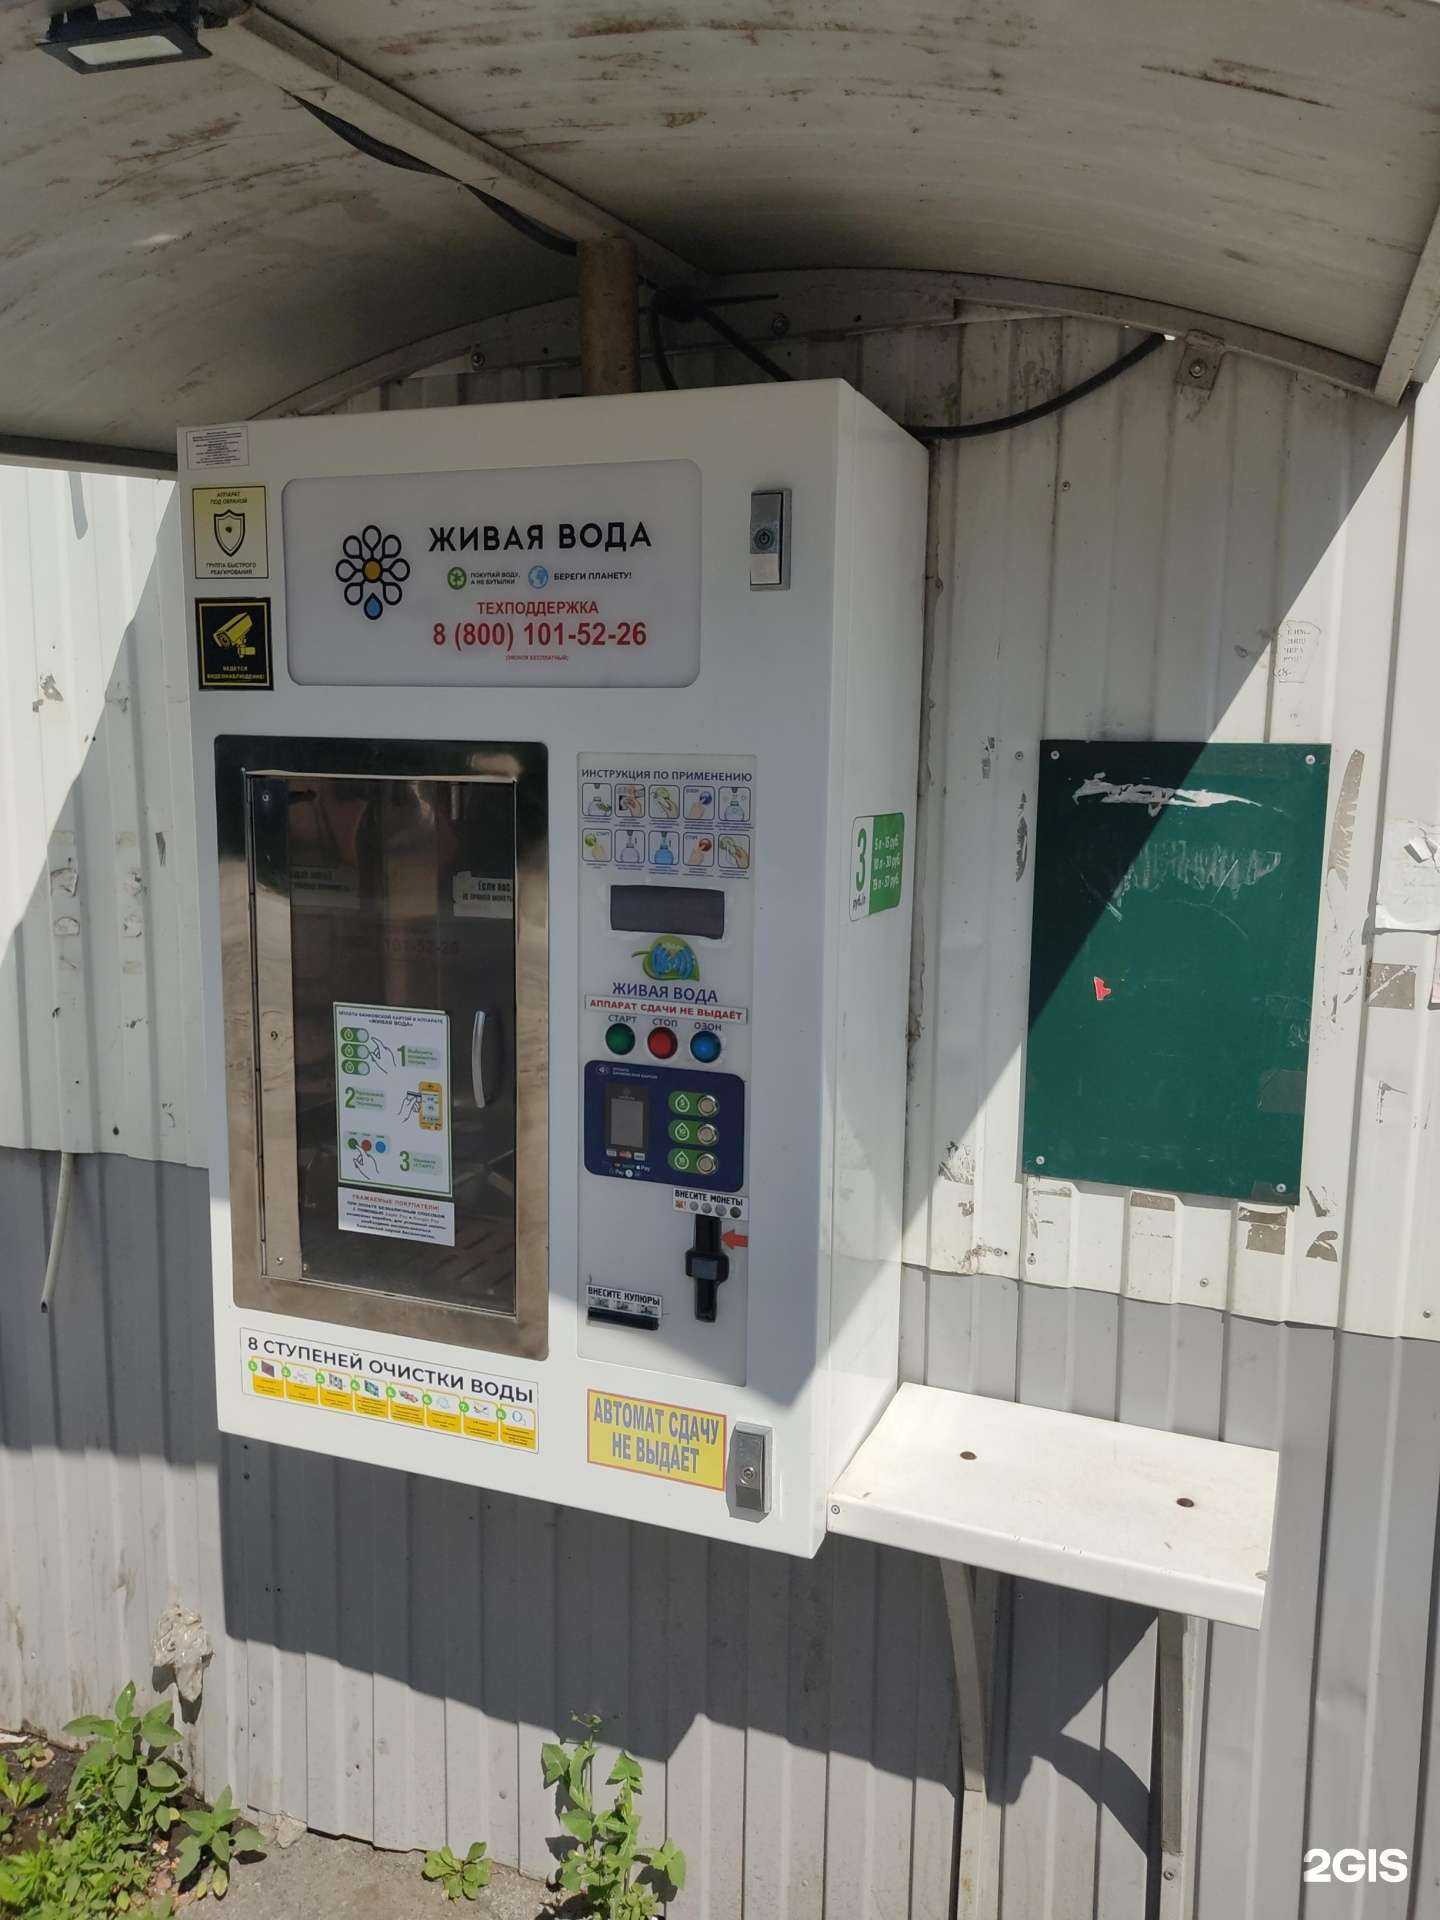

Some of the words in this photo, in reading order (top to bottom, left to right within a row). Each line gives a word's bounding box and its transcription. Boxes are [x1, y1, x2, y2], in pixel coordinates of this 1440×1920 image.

[429, 524, 544, 551] ЖИВАЯ
[558, 521, 652, 552] ВОДА
[554, 572, 587, 581] БЕРЕГИ
[588, 571, 632, 580] ПЛАНЕТУ!
[478, 601, 599, 616] ТЕХПОДДЕРЖКА
[433, 623, 446, 645] 8
[455, 622, 514, 651] (800)
[524, 622, 647, 646] 101-52-26
[582, 769, 650, 780] ИНСТРУКЦИЯ
[653, 771, 669, 780] ПО
[672, 772, 752, 782] ПРИМЕНЕНИЮ
[856, 828, 866, 892] 3
[612, 982, 669, 999] ЖИВАЯ
[674, 987, 718, 1005] ВОДА
[590, 999, 637, 1011] АППАРАТ
[641, 1004, 677, 1014] СДАЧИ
[680, 1007, 694, 1015] НЕ
[608, 1014, 637, 1023] СТАРТ
[652, 1018, 678, 1027] СТОП
[694, 1022, 722, 1032] ОЗОН
[398, 1045, 405, 1066] 1
[345, 1087, 356, 1109] 2
[400, 1151, 410, 1172] 3
[674, 1190, 707, 1201] ВНЕСИТЕ
[710, 1195, 743, 1206] МОНЕТЫ
[588, 1286, 621, 1299] ВНЕСИТЕ
[624, 1292, 660, 1306] КУПЮРЫ
[248, 1337, 257, 1350] 8
[264, 1340, 362, 1372] СТУПЕНЕЙ
[369, 1360, 464, 1390] ОЧИСТКИ
[471, 1379, 533, 1403] ВОДЫ
[594, 1398, 664, 1434] АВТОМАТ
[669, 1412, 719, 1445] СДАЧУ
[612, 1432, 631, 1460] НЕ
[636, 1437, 699, 1473] ВЫДАЕТ
